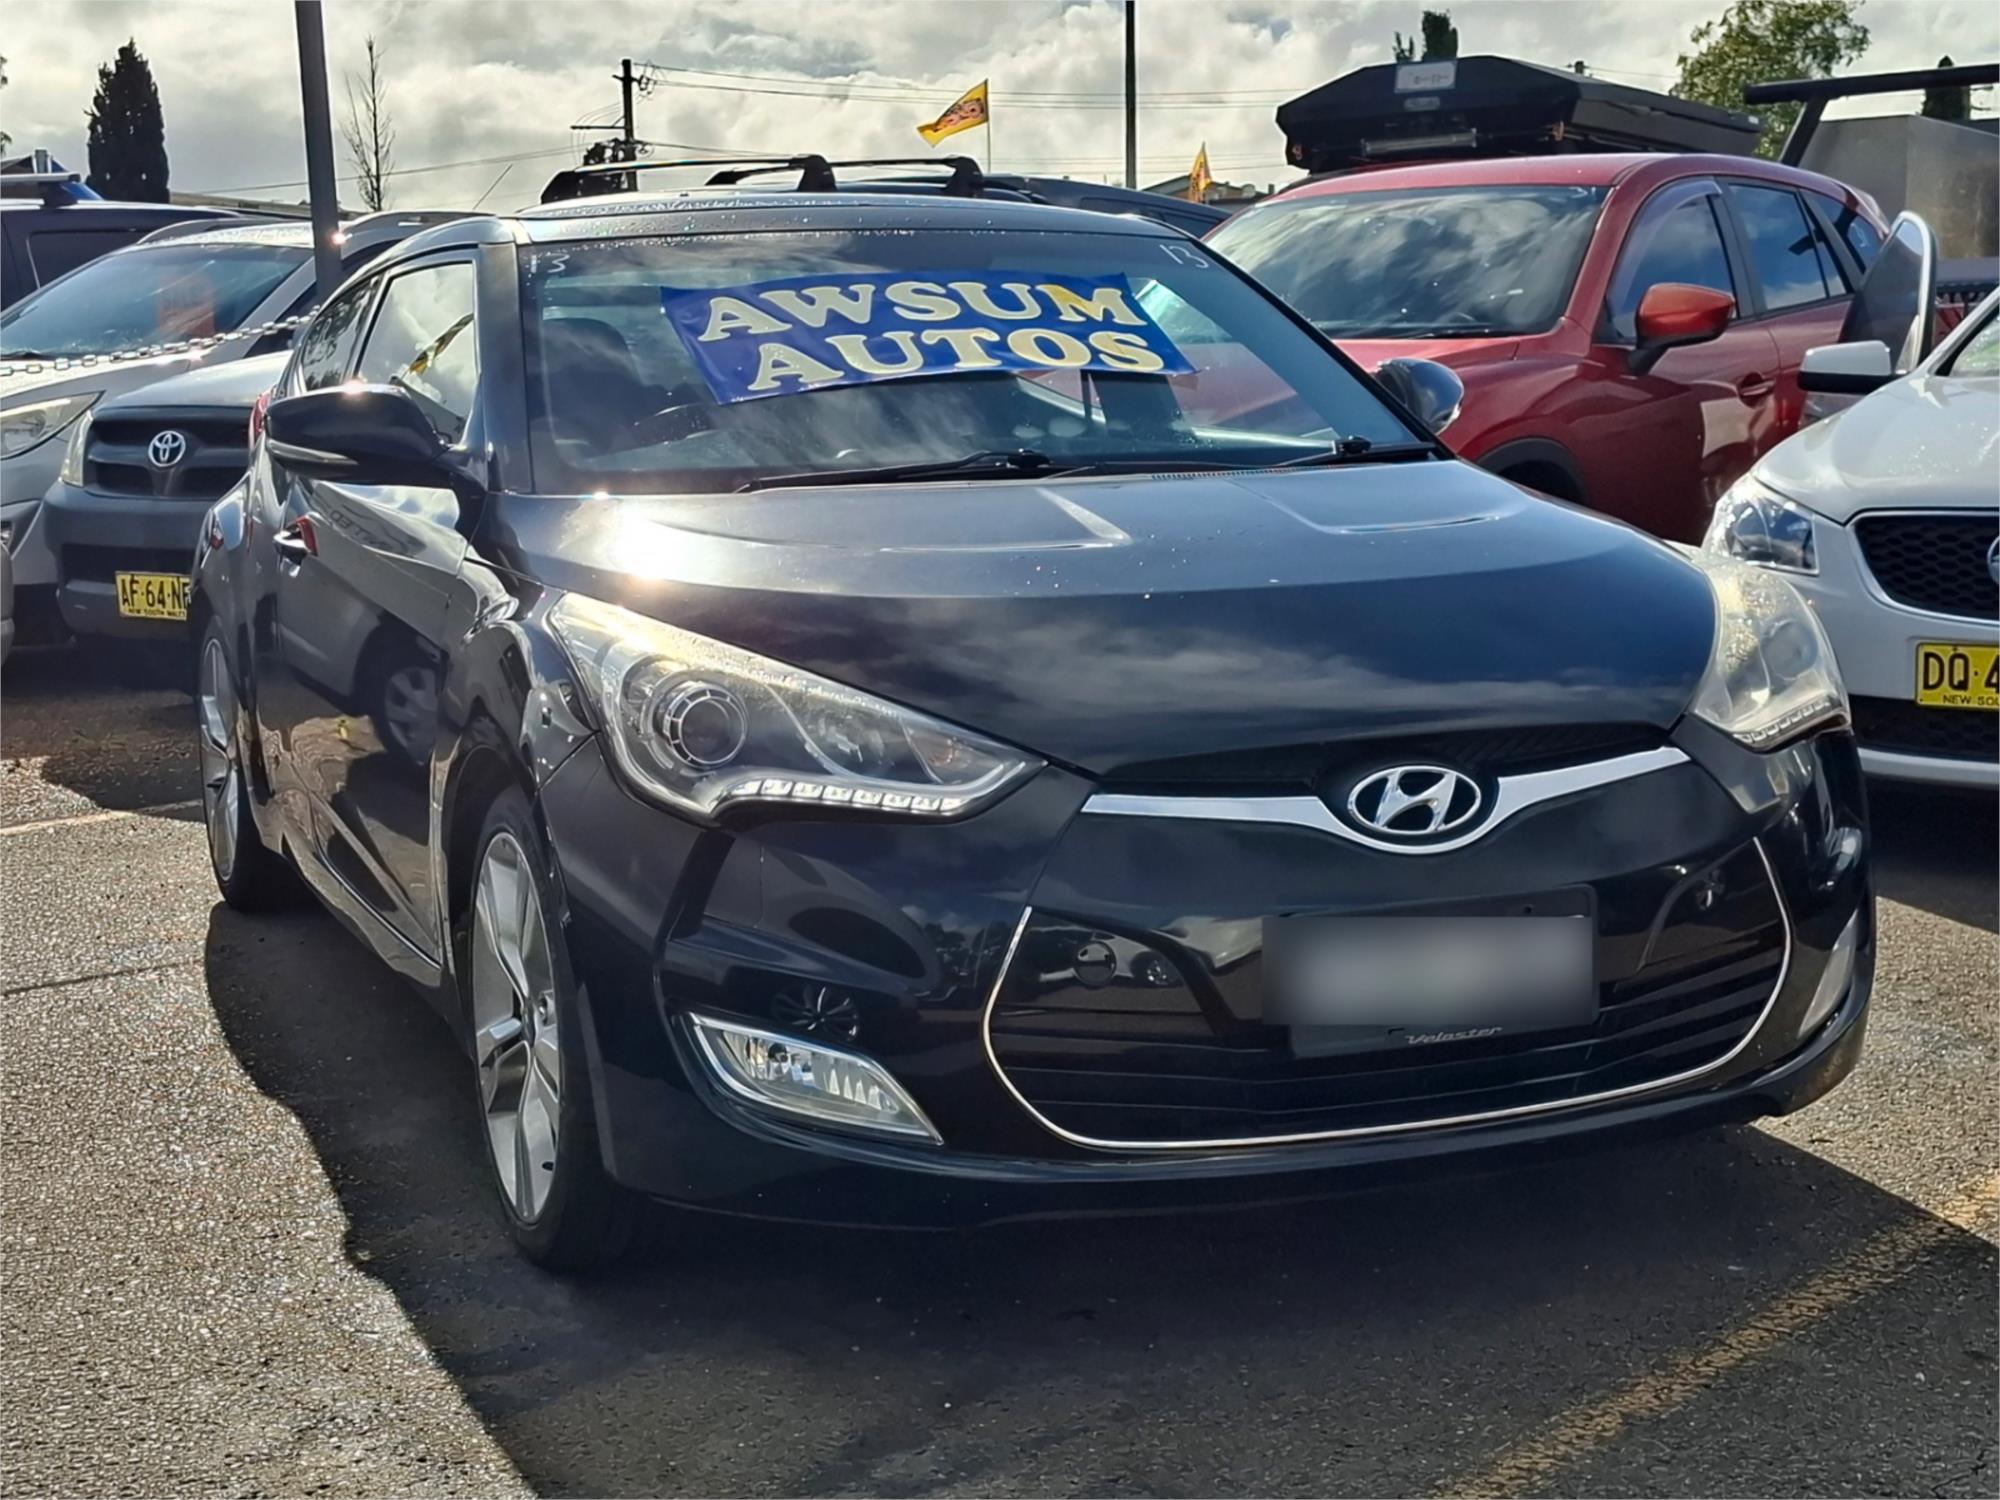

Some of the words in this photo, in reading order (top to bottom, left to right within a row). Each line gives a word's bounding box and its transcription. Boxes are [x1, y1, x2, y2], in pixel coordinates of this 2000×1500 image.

[1160, 244, 1209, 269] 13
[698, 281, 1147, 342] AWSUM
[747, 328, 1164, 391] AUTOS
[1943, 694, 1971, 705] NEW
